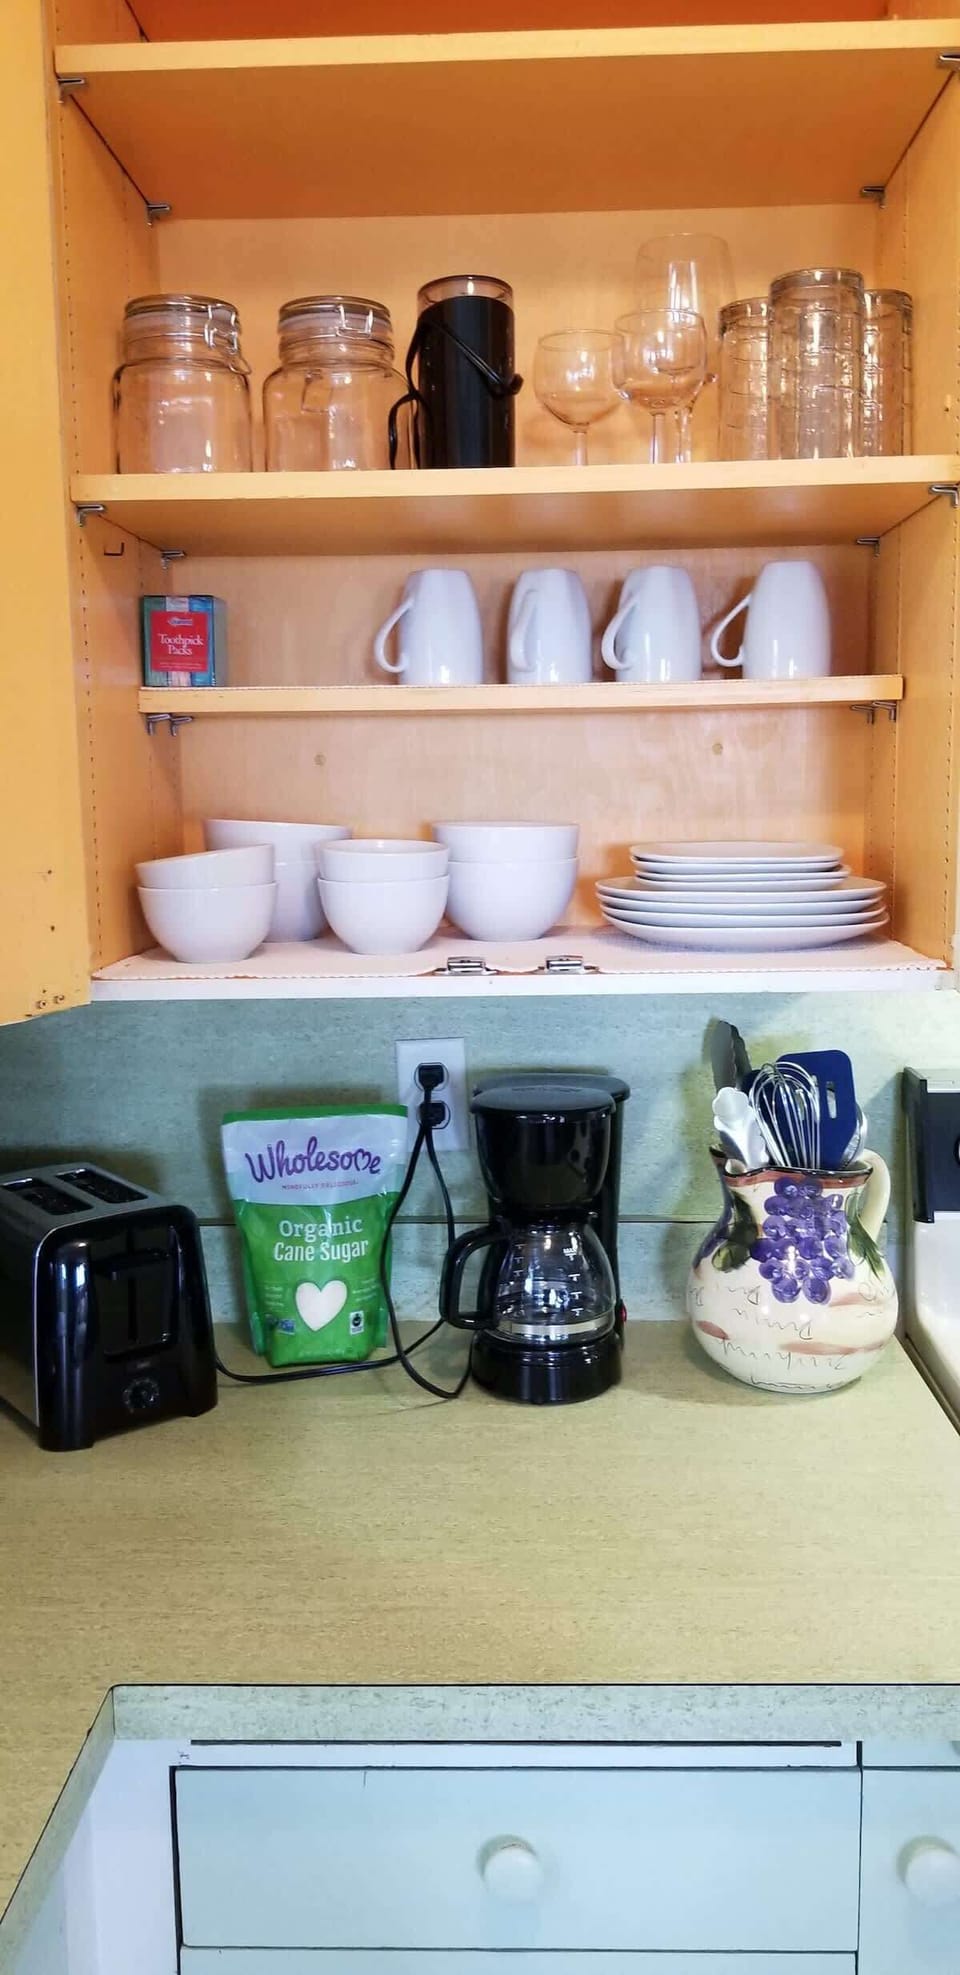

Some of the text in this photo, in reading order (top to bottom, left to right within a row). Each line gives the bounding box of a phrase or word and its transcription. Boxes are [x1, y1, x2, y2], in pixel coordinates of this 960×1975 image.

[157, 633, 203, 648] Toothpick
[168, 644, 192, 655] Packs
[244, 1135, 381, 1183] Wholesome
[279, 1215, 364, 1243] Organic
[274, 1239, 369, 1264] Cane Sugar
